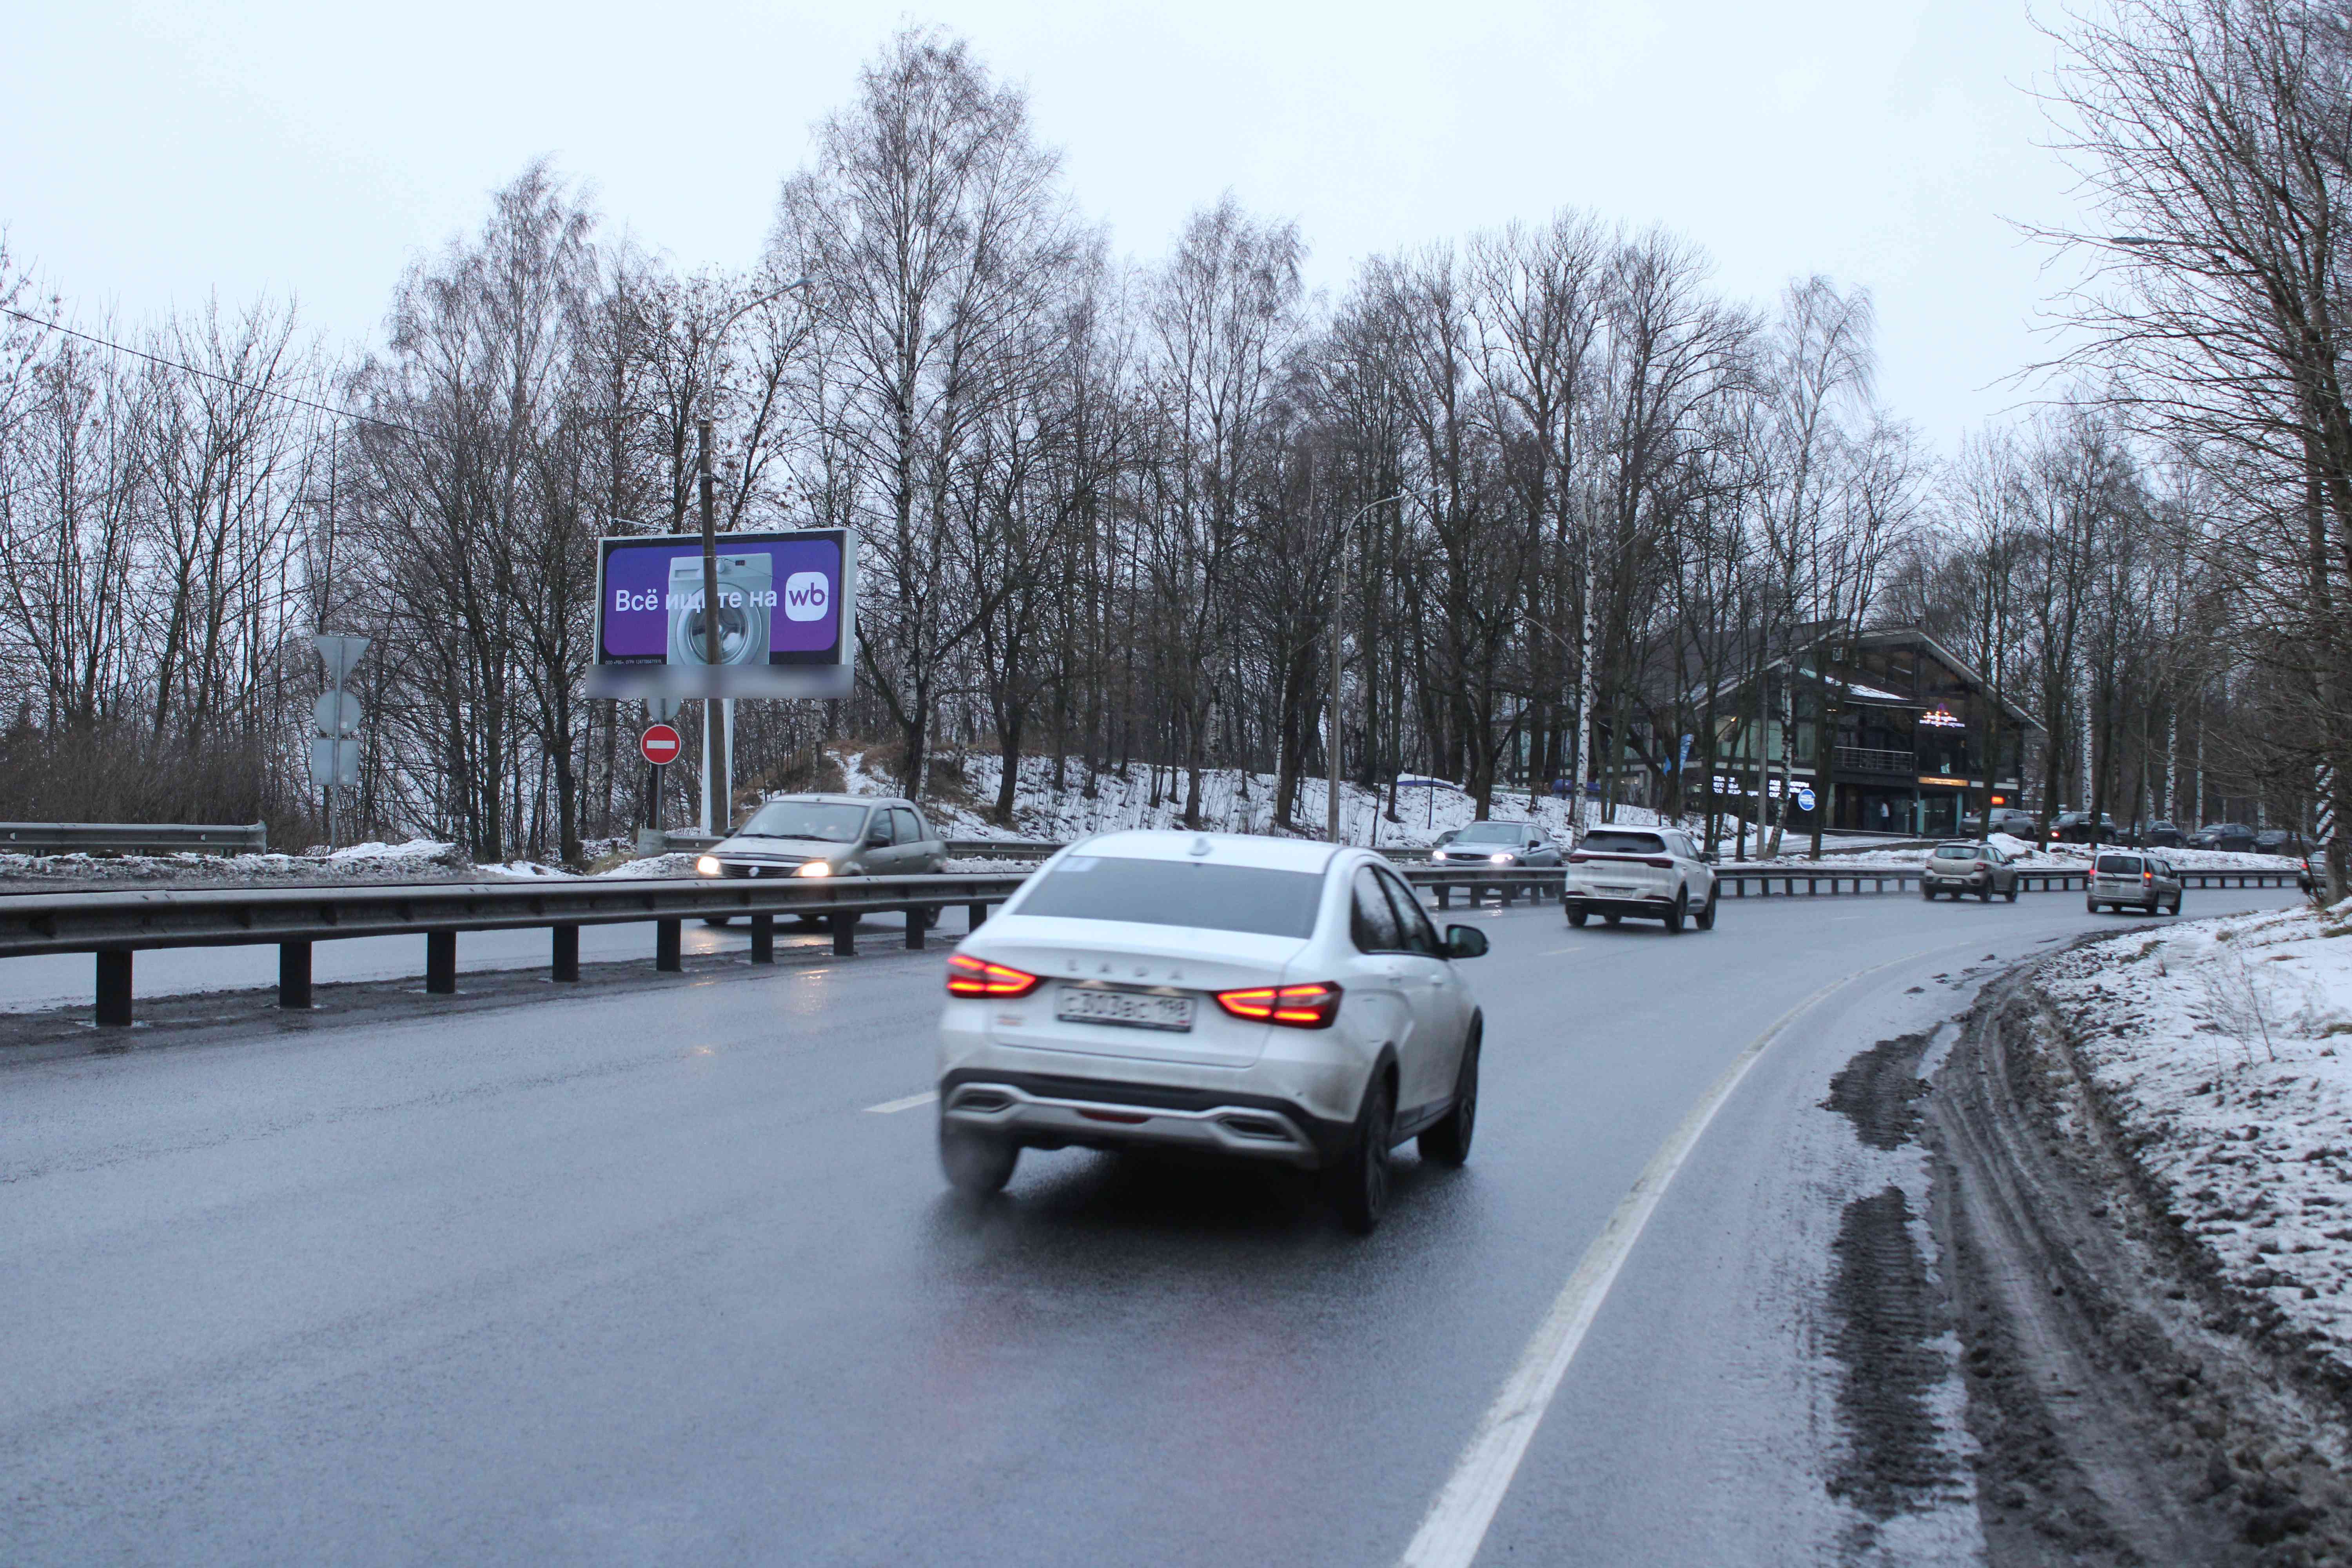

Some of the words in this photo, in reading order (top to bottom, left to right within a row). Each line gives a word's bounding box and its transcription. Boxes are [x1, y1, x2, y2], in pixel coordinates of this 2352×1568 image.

[616, 589, 658, 611] Всё
[750, 590, 777, 608] на
[788, 582, 826, 606] wb
